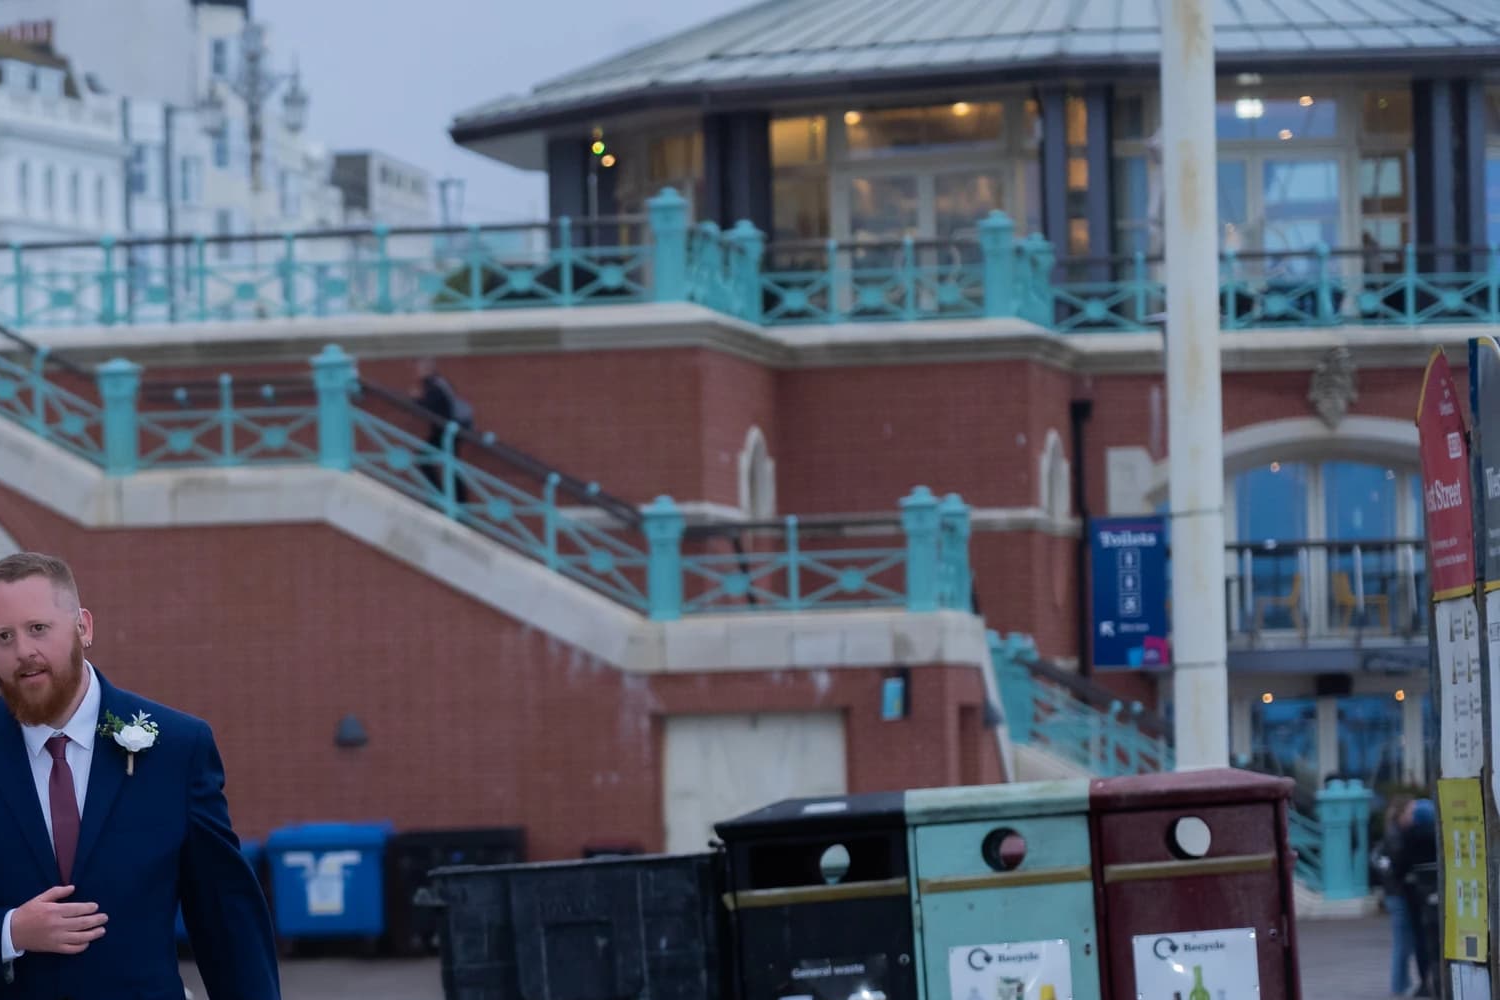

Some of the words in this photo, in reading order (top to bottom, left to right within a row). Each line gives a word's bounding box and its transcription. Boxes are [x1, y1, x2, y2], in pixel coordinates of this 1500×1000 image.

[1435, 477, 1462, 510] Street
[1099, 530, 1157, 548] Toilets
[1184, 941, 1225, 953] Recycle
[998, 951, 1039, 963] Recycle
[791, 965, 832, 979] General
[834, 963, 865, 976] waste
